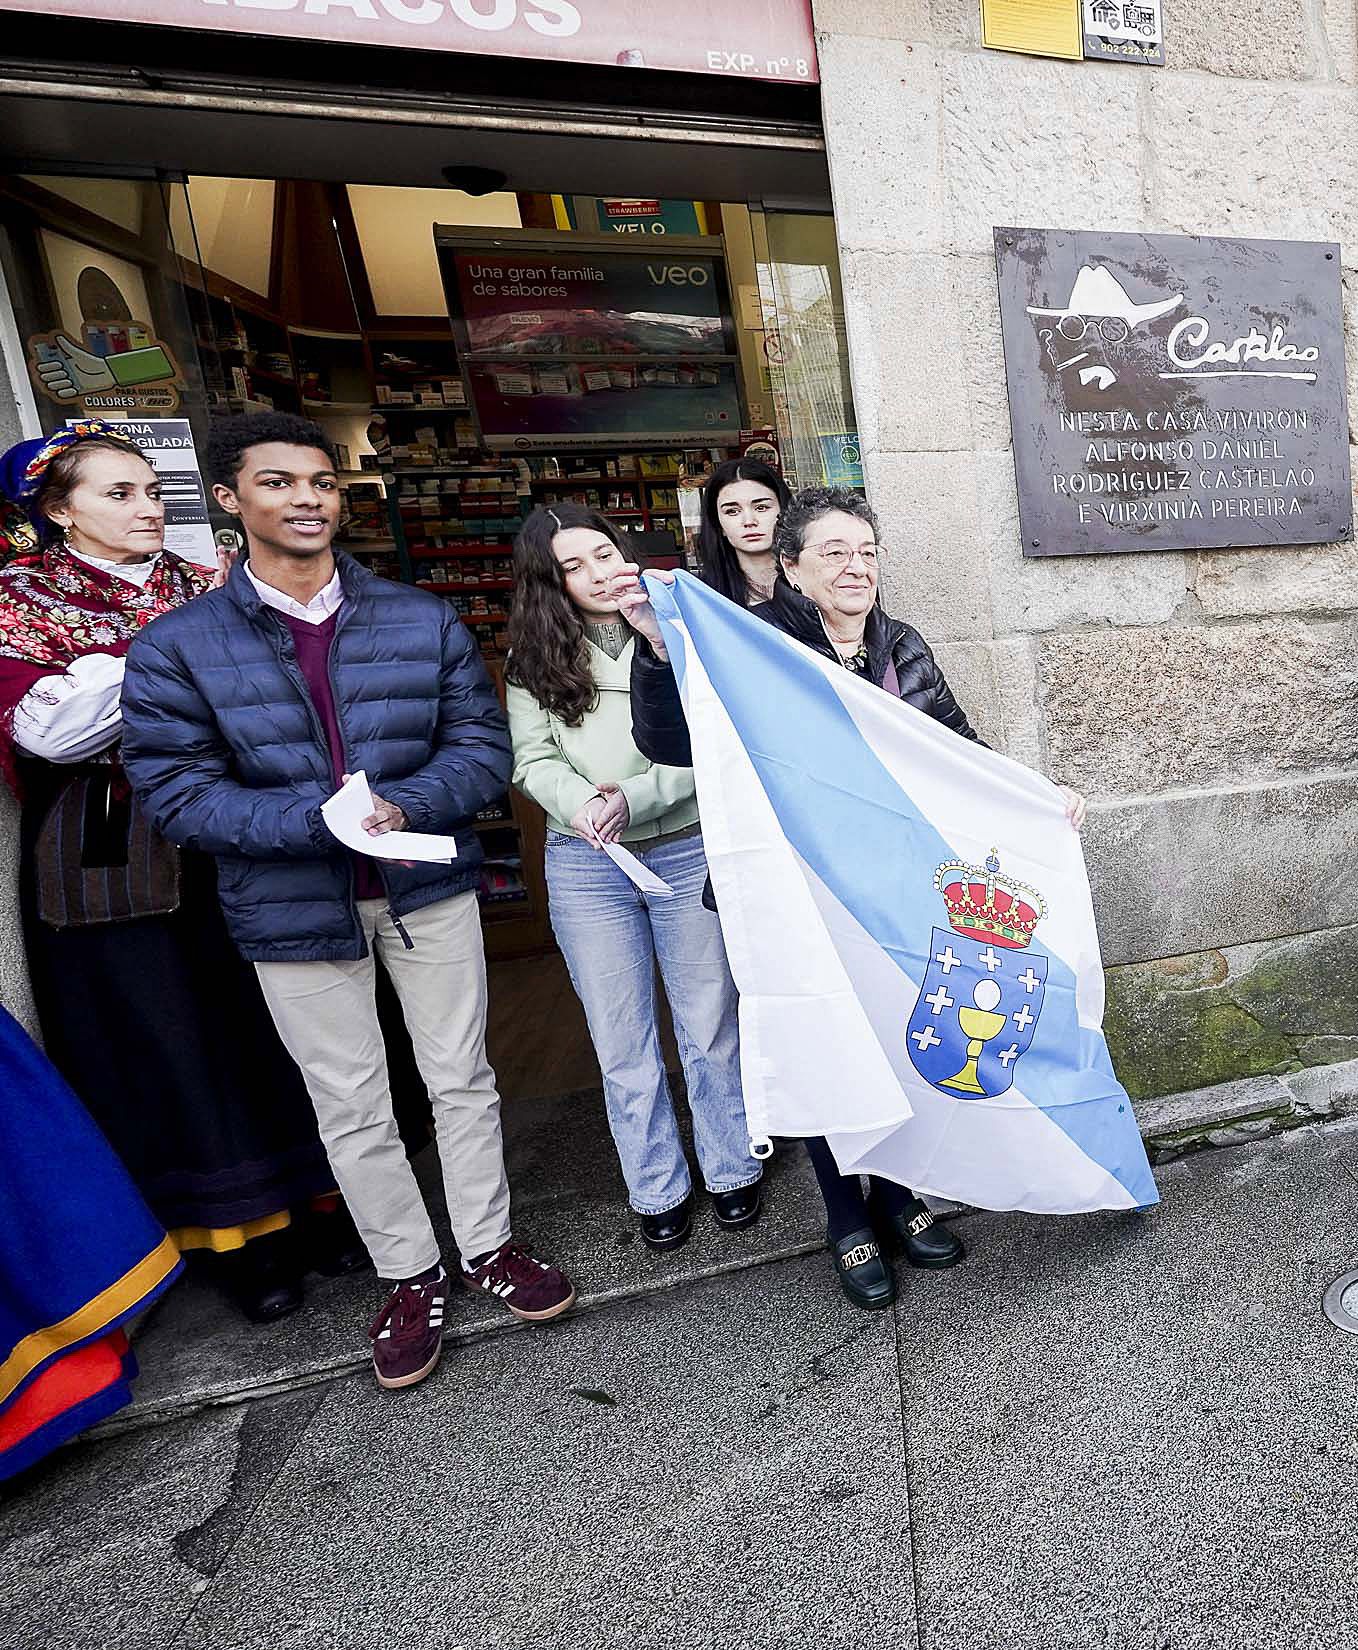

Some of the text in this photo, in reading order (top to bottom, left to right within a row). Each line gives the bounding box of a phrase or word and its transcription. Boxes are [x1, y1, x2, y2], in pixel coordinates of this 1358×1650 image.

[1101, 43, 1160, 57] 902 222 224
[707, 51, 760, 72] EXP.
[796, 58, 809, 76] 8
[469, 264, 605, 283] Una gran familia
[648, 265, 709, 286] veo
[472, 281, 568, 298] de sabores
[84, 396, 135, 407] COLORES
[1059, 409, 1308, 432] NESTA CASA VIVIRON
[130, 437, 194, 448] GILADA
[1085, 439, 1285, 463] ALFONSO DANIEL
[1052, 468, 1315, 493] RODRÍGUEZ CASTELAO
[1078, 497, 1304, 523] E VIRXINIA PEREIRA
